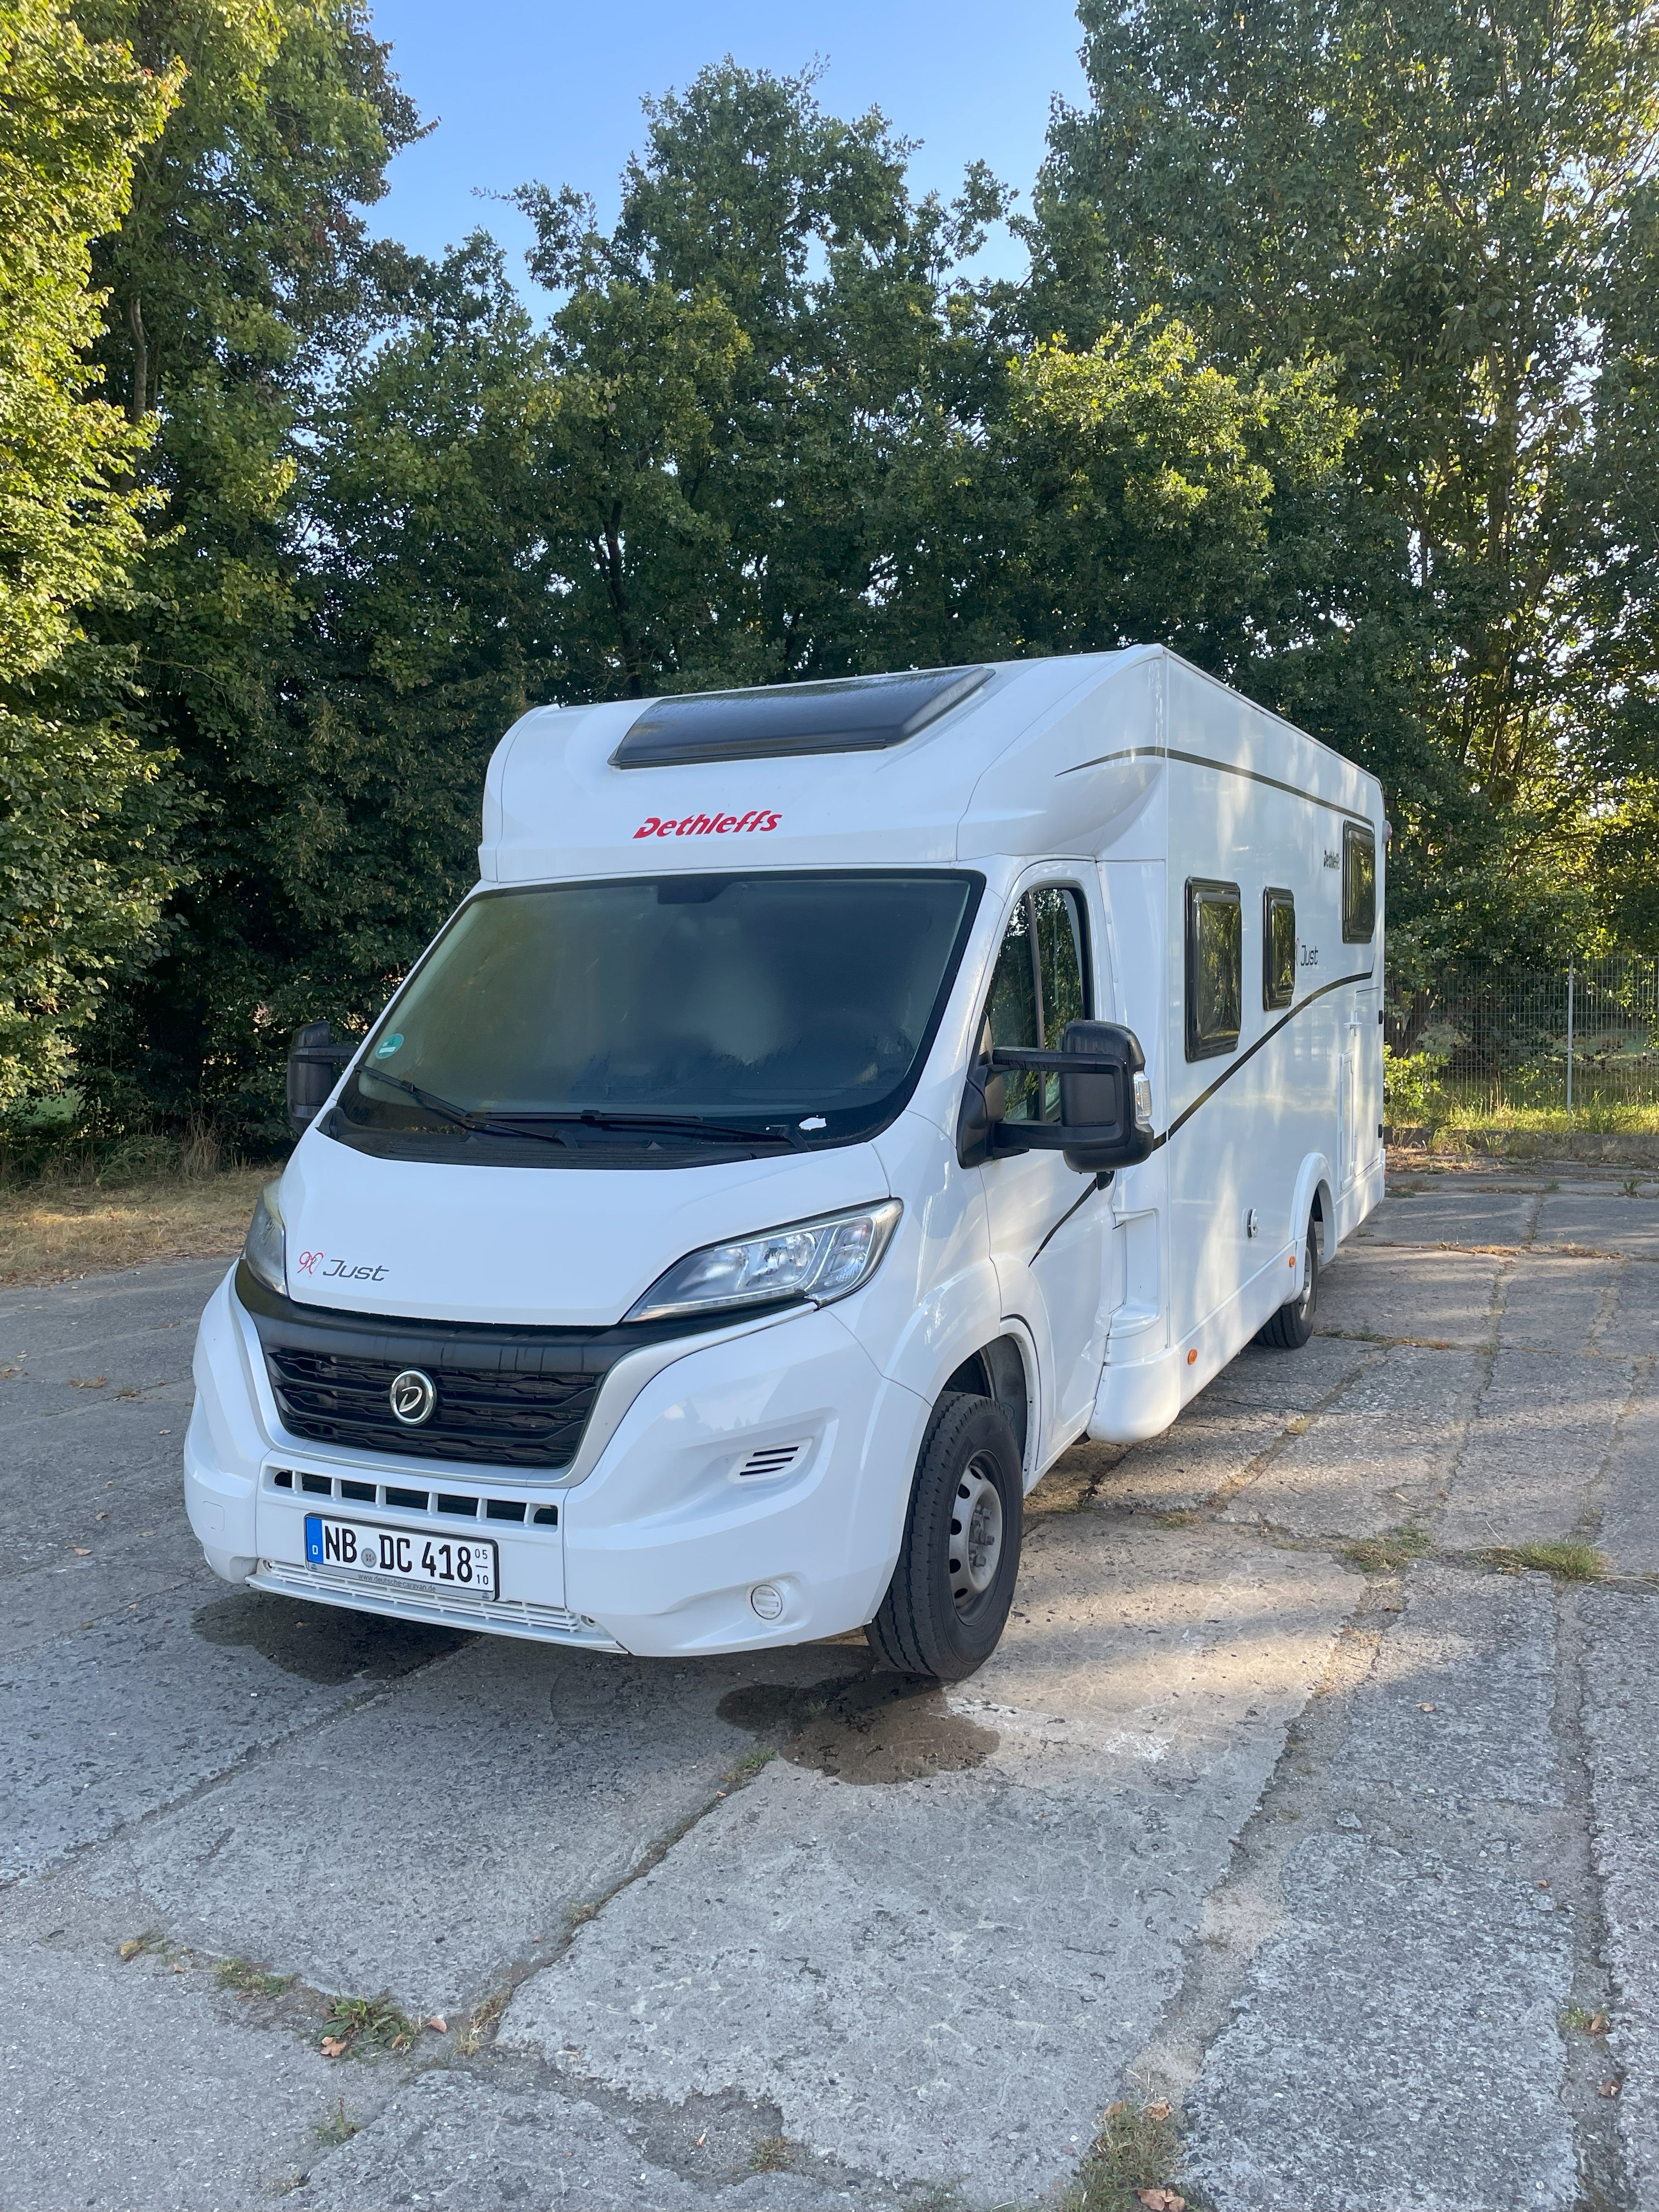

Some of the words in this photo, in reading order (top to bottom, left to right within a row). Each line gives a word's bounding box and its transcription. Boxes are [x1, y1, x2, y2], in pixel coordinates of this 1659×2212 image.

[632, 810, 782, 839] Dethleffs
[1301, 945, 1318, 966] Just
[323, 1259, 390, 1282] Just
[312, 1544, 318, 1555] D
[325, 1525, 357, 1563] NB
[379, 1534, 413, 1573] DC
[421, 1542, 472, 1583] 418
[475, 1549, 488, 1559] 05
[358, 1573, 436, 1593] www.deutsche-caravan.de
[477, 1574, 488, 1585] 10
